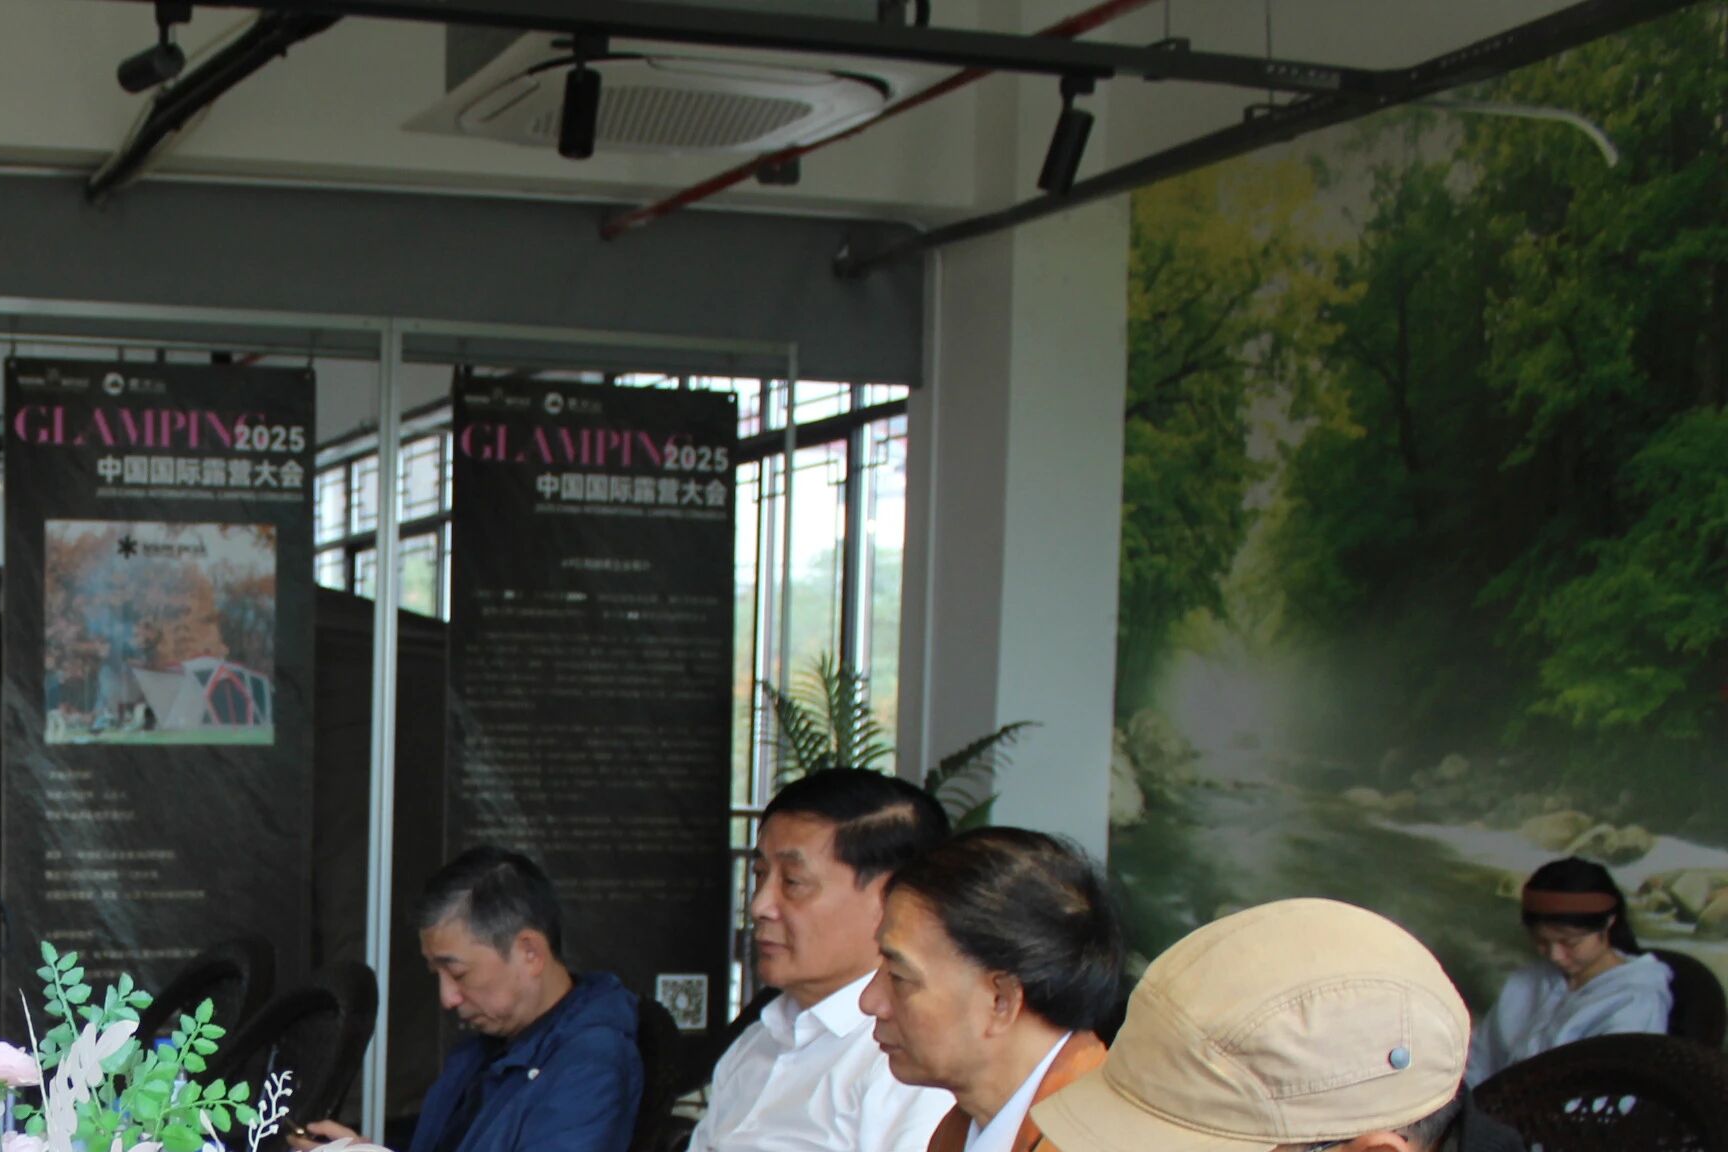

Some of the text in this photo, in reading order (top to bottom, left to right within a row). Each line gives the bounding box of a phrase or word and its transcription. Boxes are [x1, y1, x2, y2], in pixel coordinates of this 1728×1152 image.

[234, 425, 305, 451] 2025
[98, 455, 304, 488] 中国国际露营大会
[664, 446, 728, 473] 2025
[536, 472, 728, 508] 中国国际露营大会
